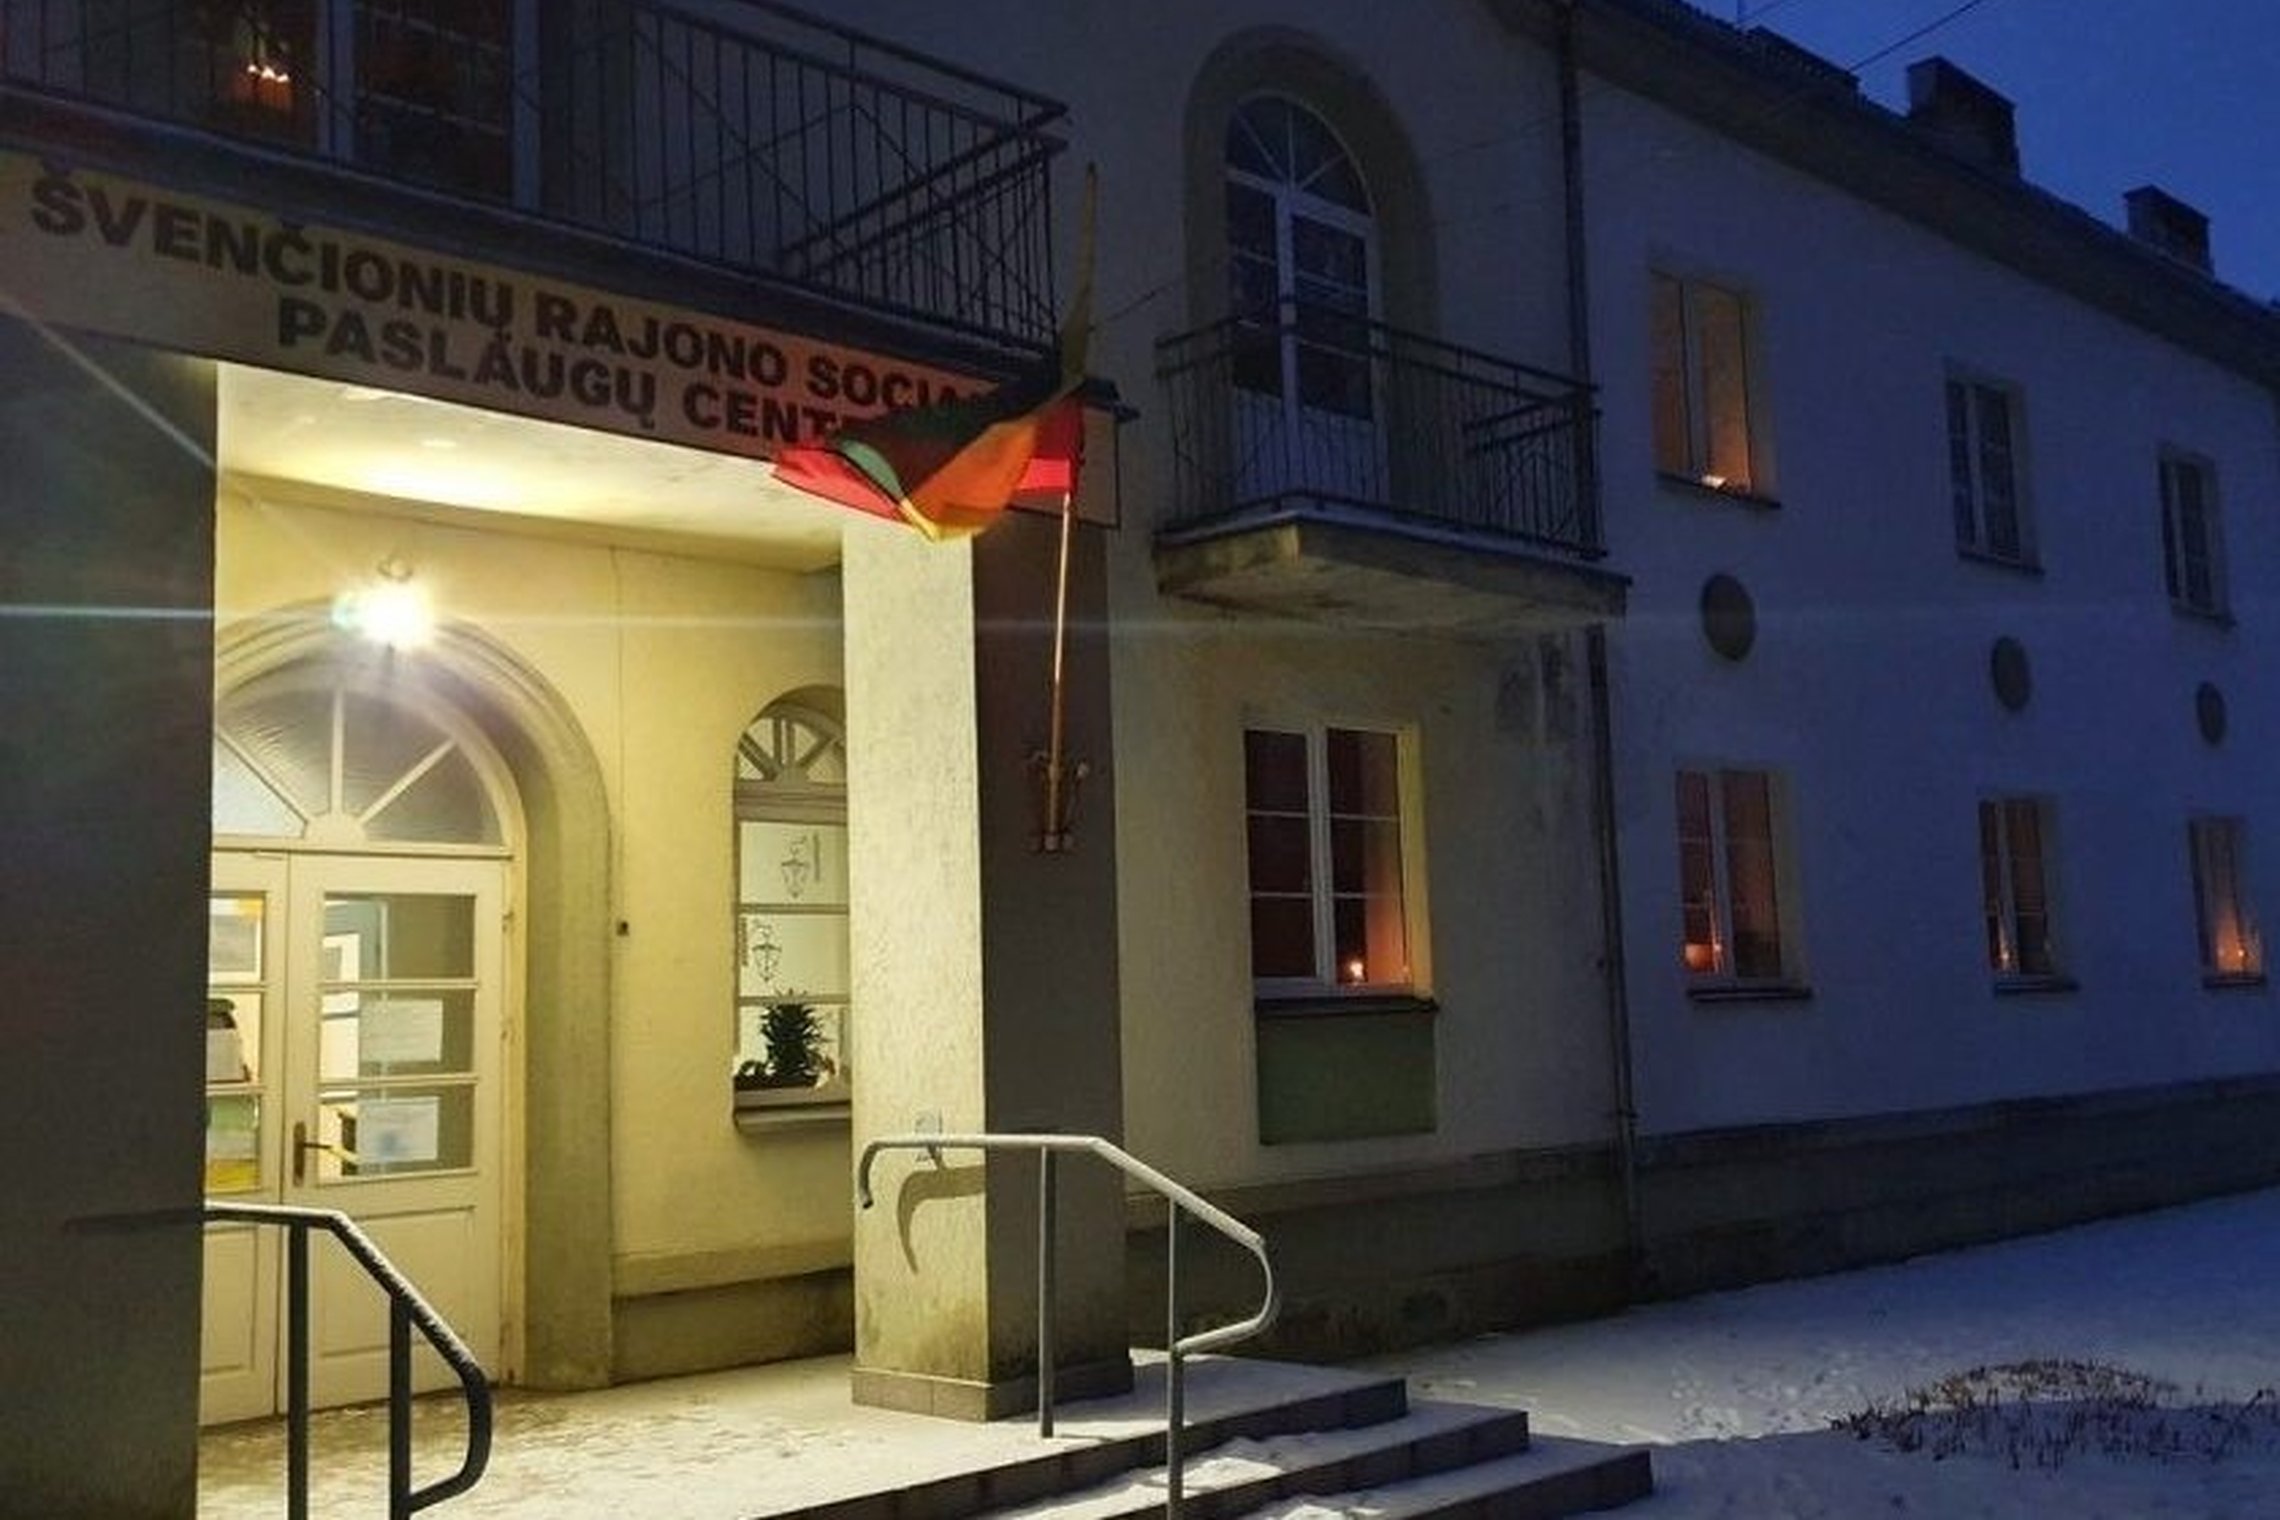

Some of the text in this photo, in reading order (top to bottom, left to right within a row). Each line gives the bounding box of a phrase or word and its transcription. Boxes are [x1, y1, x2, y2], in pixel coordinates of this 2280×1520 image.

[31, 158, 982, 410] ŠVENČIONIŲ RAJONO SOCIA
[278, 297, 840, 444] PASLAUGŲ CENT
